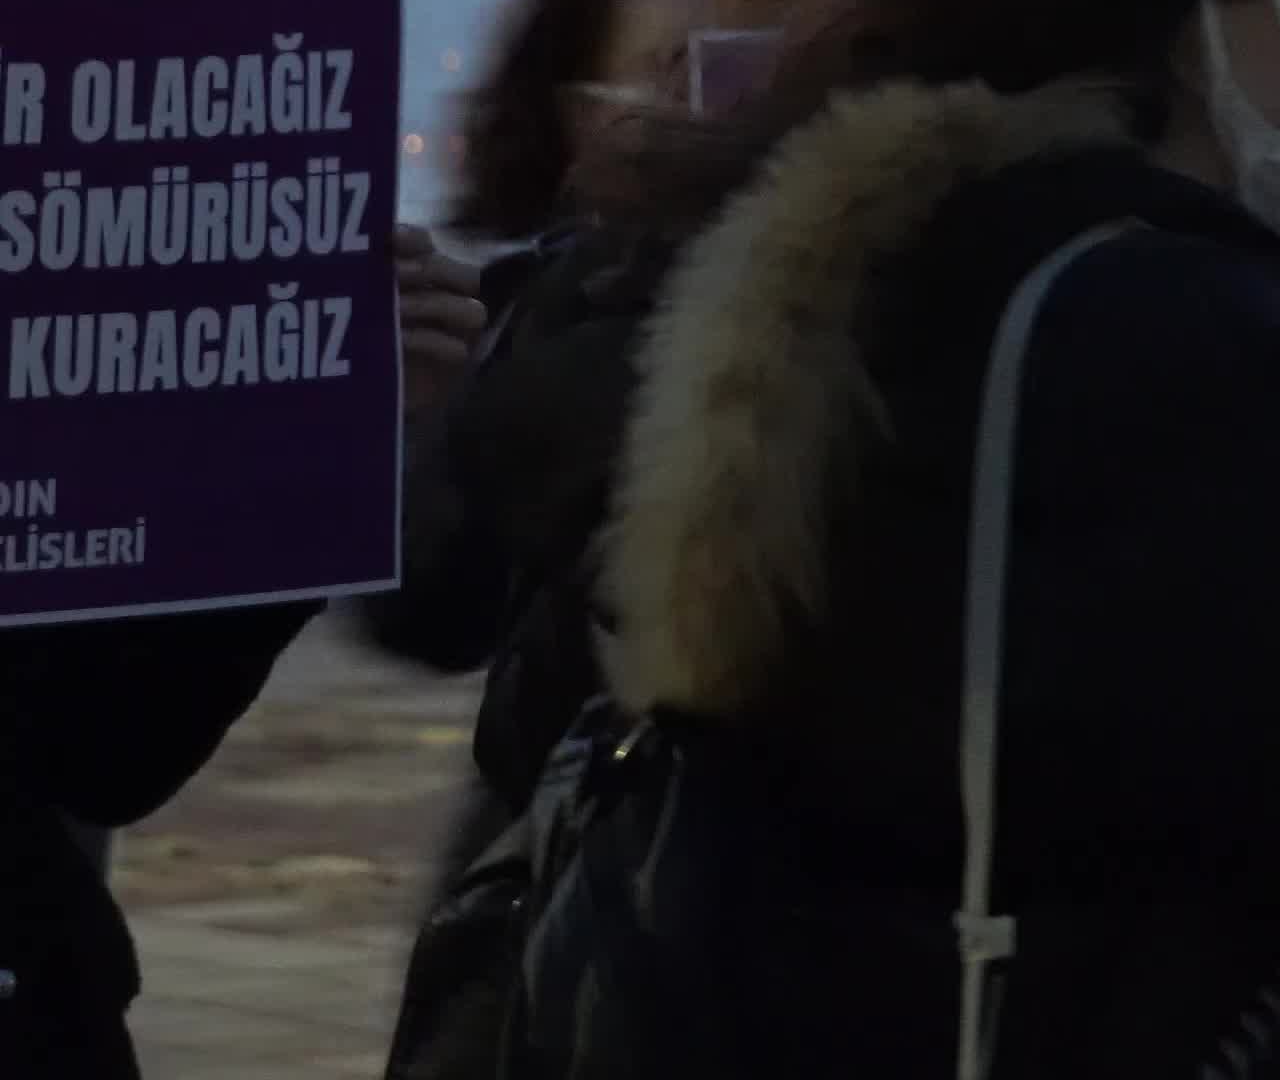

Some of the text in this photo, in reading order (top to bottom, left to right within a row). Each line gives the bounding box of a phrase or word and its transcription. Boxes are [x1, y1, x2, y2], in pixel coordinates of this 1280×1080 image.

[71, 32, 353, 143] OLACAĞIZ
[0, 157, 370, 273] SÖMÜRÜSÜZ
[8, 281, 352, 400] KURACAĞIZ
[0, 517, 145, 573] LİSLERİ
